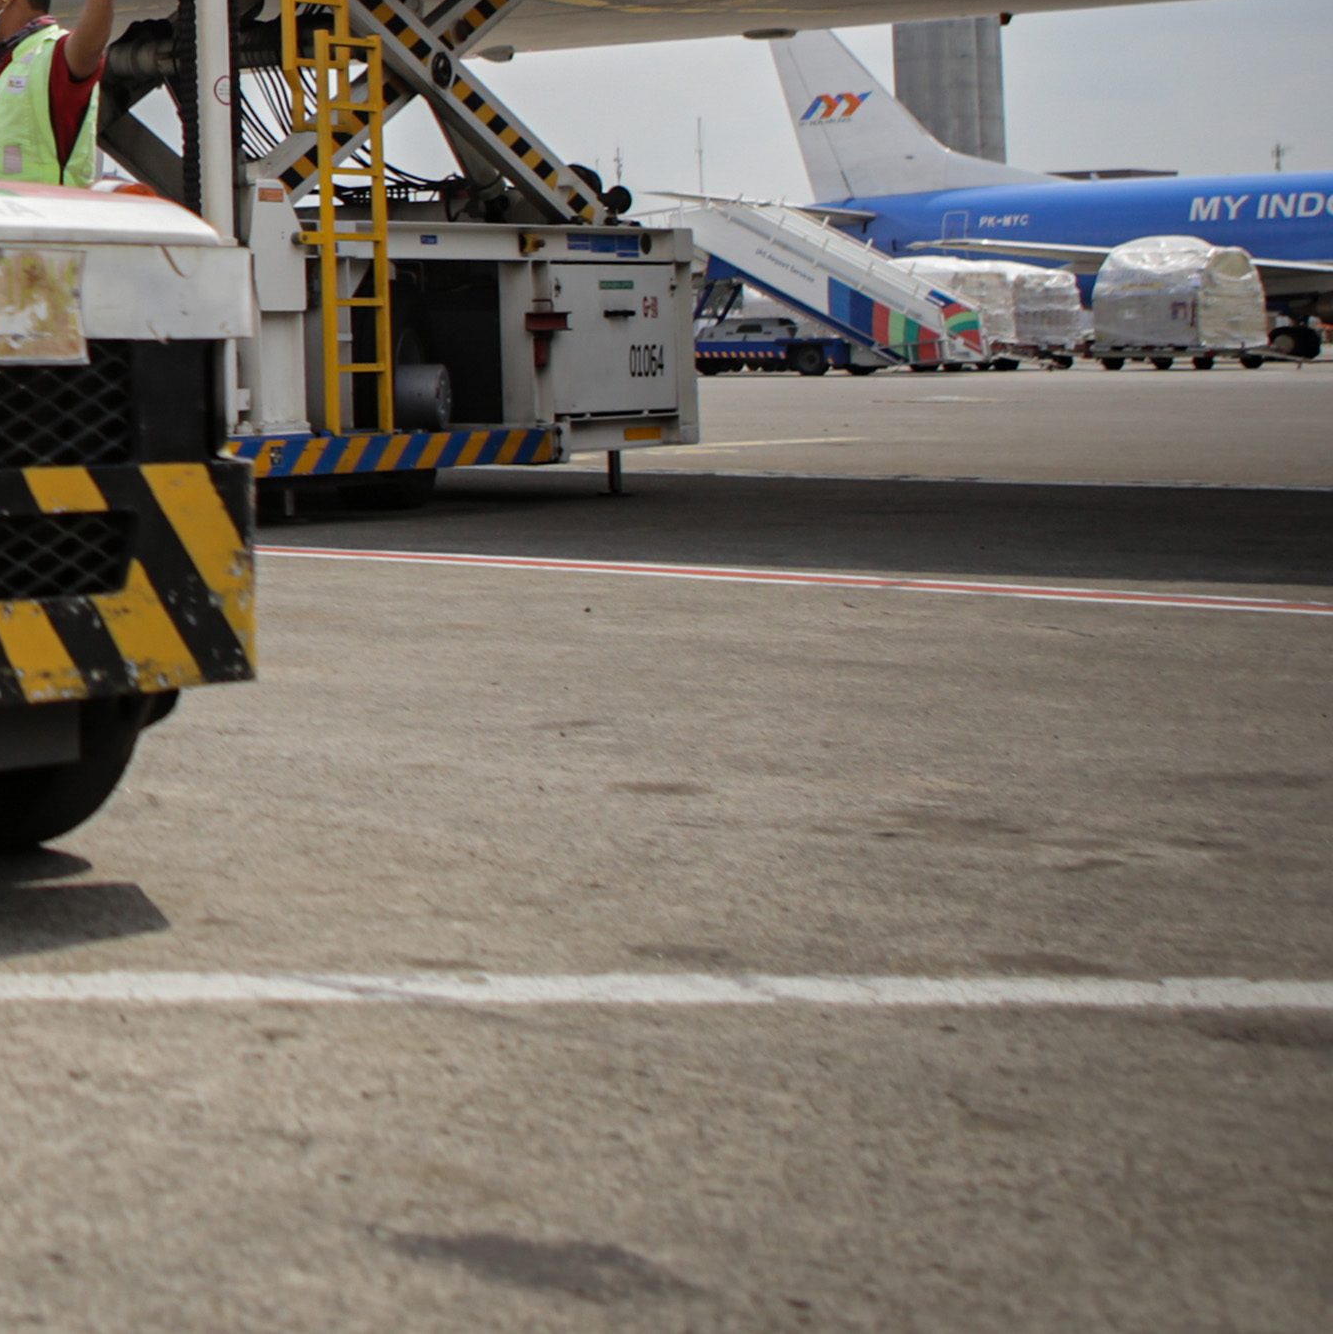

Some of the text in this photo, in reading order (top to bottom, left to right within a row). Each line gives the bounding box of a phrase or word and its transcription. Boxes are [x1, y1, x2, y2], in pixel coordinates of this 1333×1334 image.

[978, 213, 1030, 228] PK-MYC
[1188, 191, 1333, 222] MY IND
[629, 343, 665, 378] 01064
